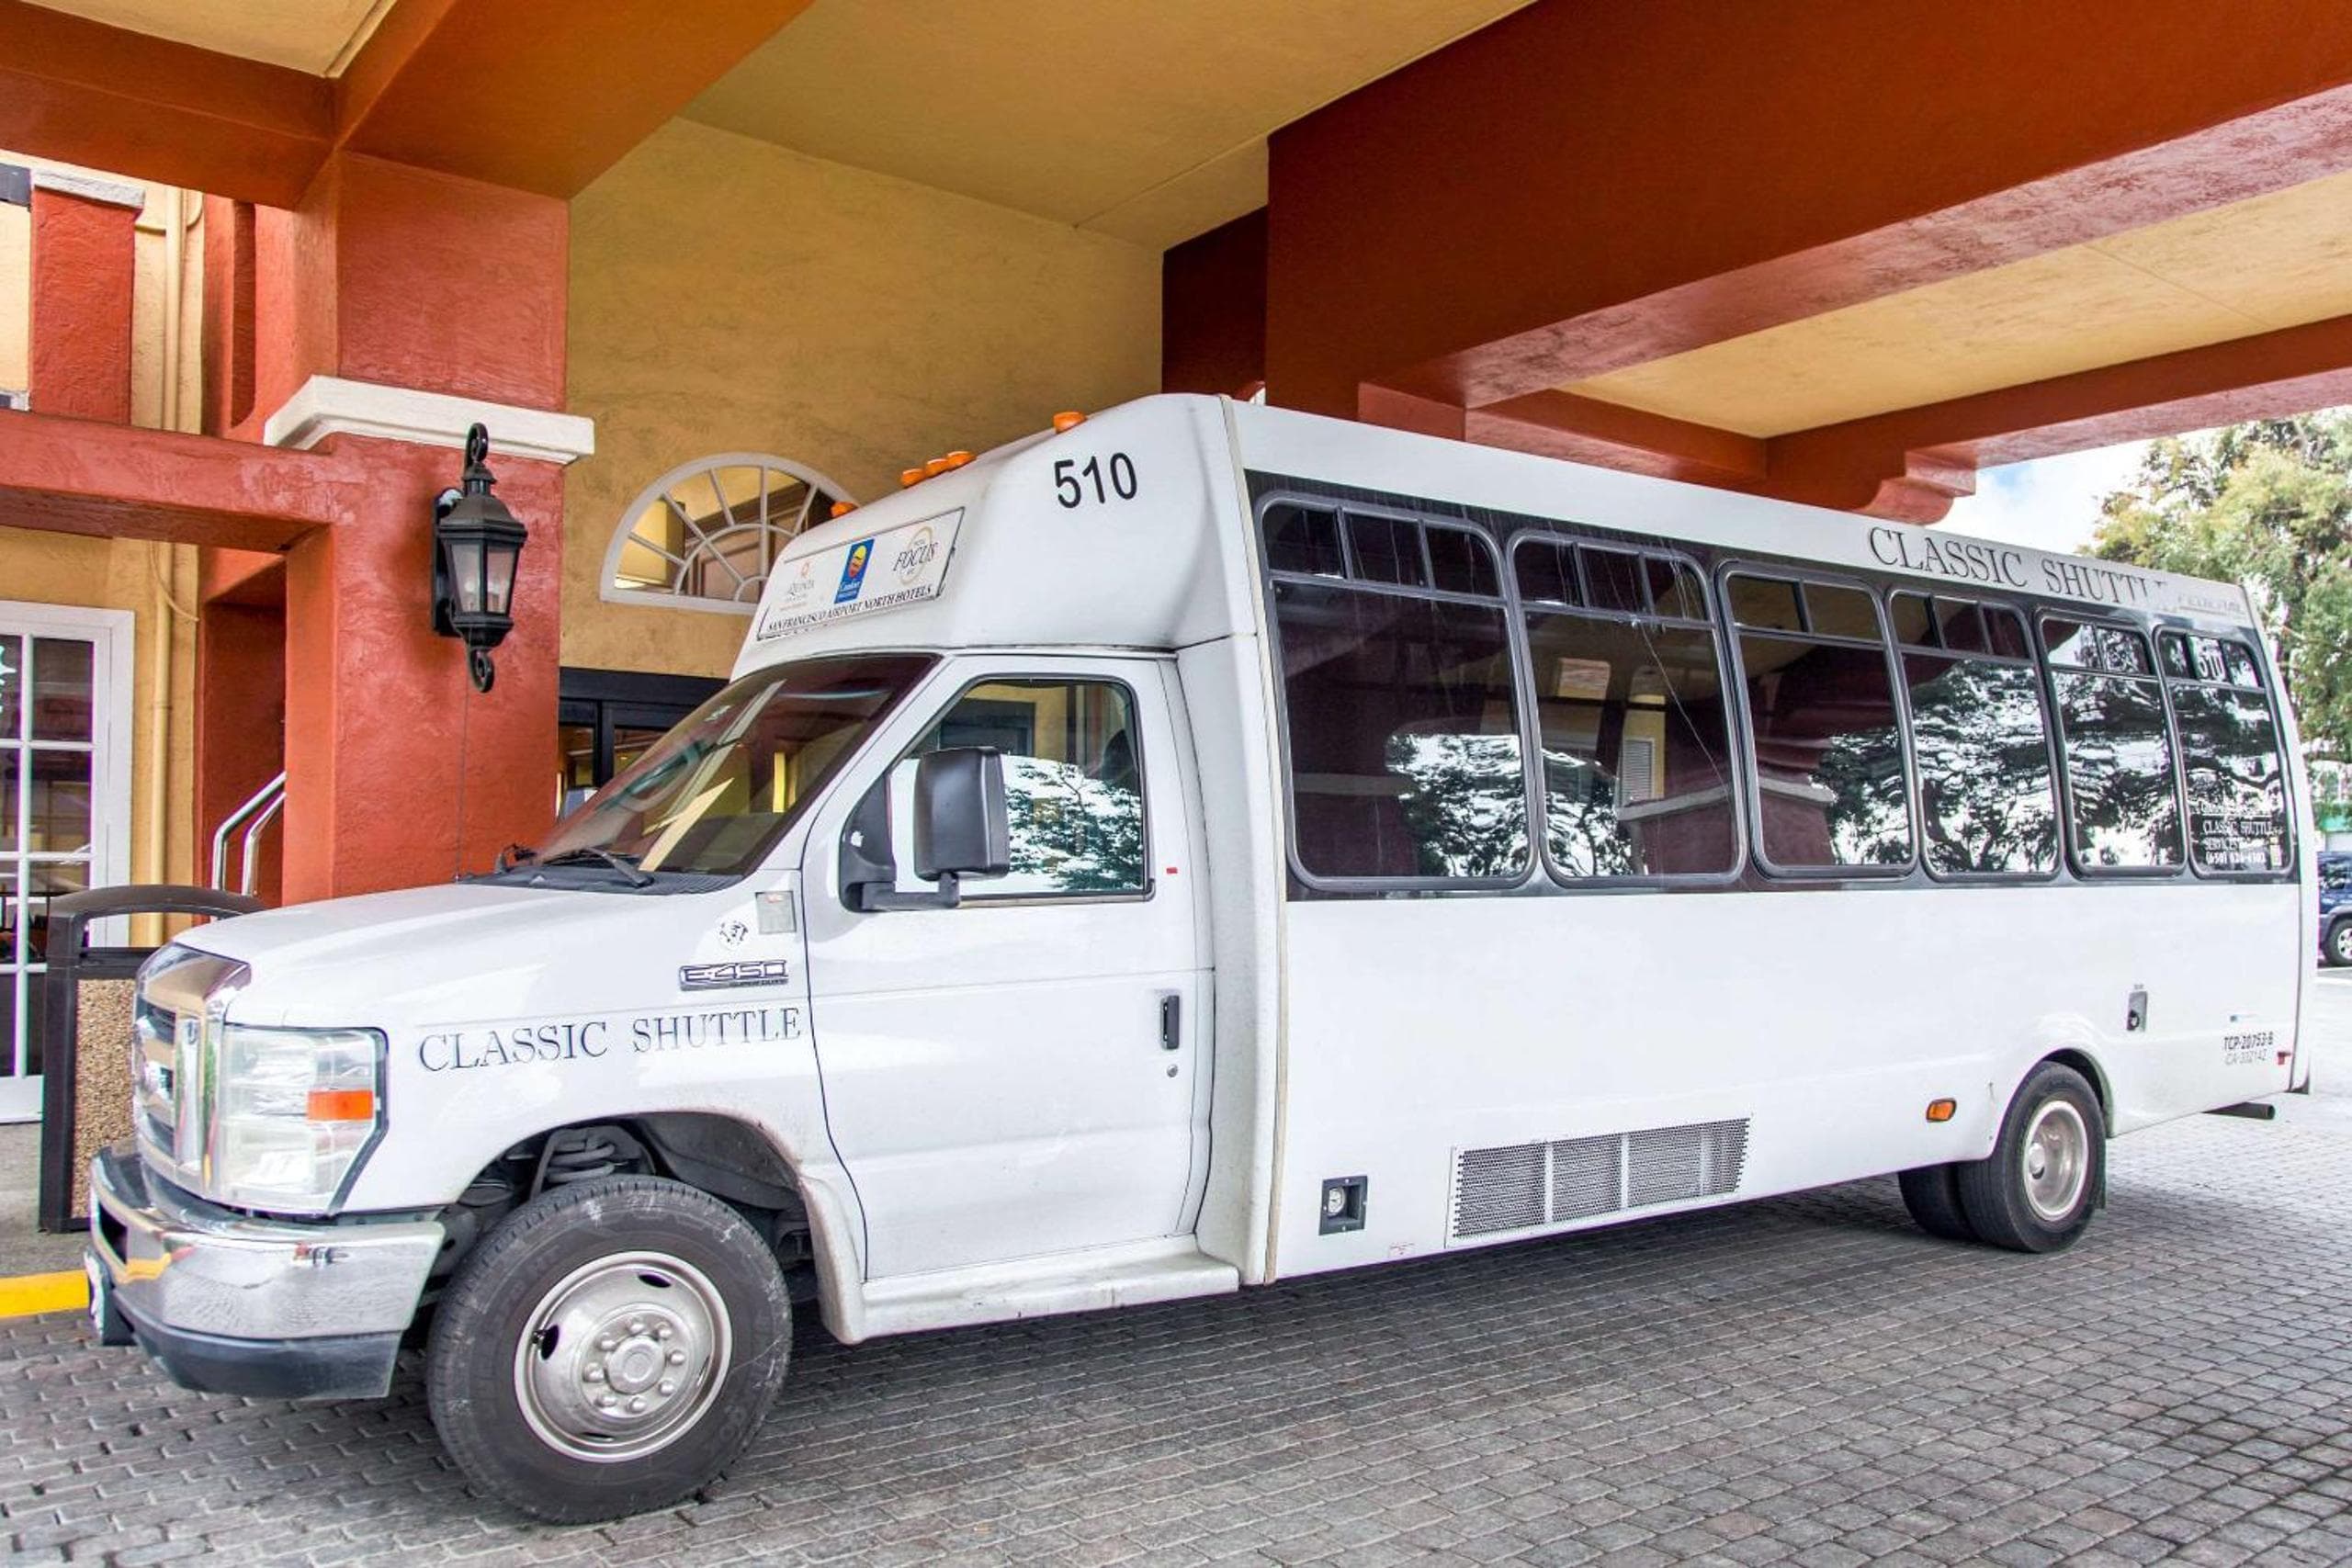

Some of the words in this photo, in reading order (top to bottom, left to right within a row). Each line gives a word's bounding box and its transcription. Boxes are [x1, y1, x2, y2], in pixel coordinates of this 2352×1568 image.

[1054, 451, 1137, 509] 510
[893, 542, 939, 572] FOCUS
[1869, 525, 2028, 588] CLASSIC
[2041, 557, 2169, 605] SHUTTL
[419, 1021, 609, 1073] CLASSIC
[632, 1007, 801, 1054] SHUTTLE
